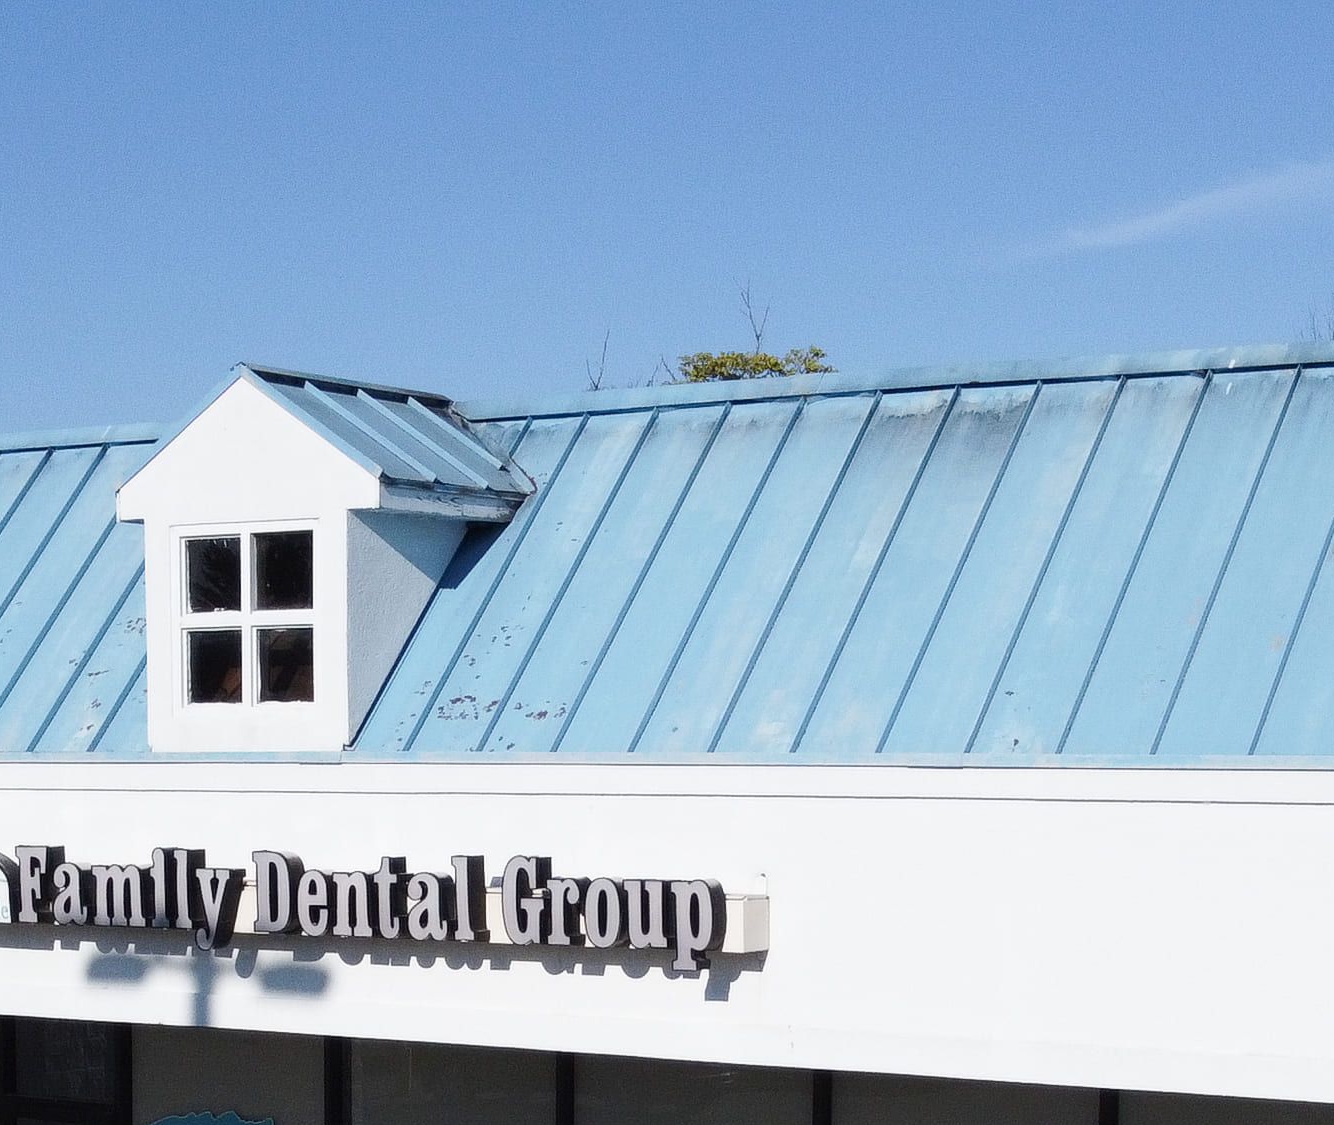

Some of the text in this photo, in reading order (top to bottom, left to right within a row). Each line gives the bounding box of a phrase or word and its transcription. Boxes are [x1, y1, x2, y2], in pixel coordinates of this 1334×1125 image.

[15, 845, 717, 971] Family Dental Group
